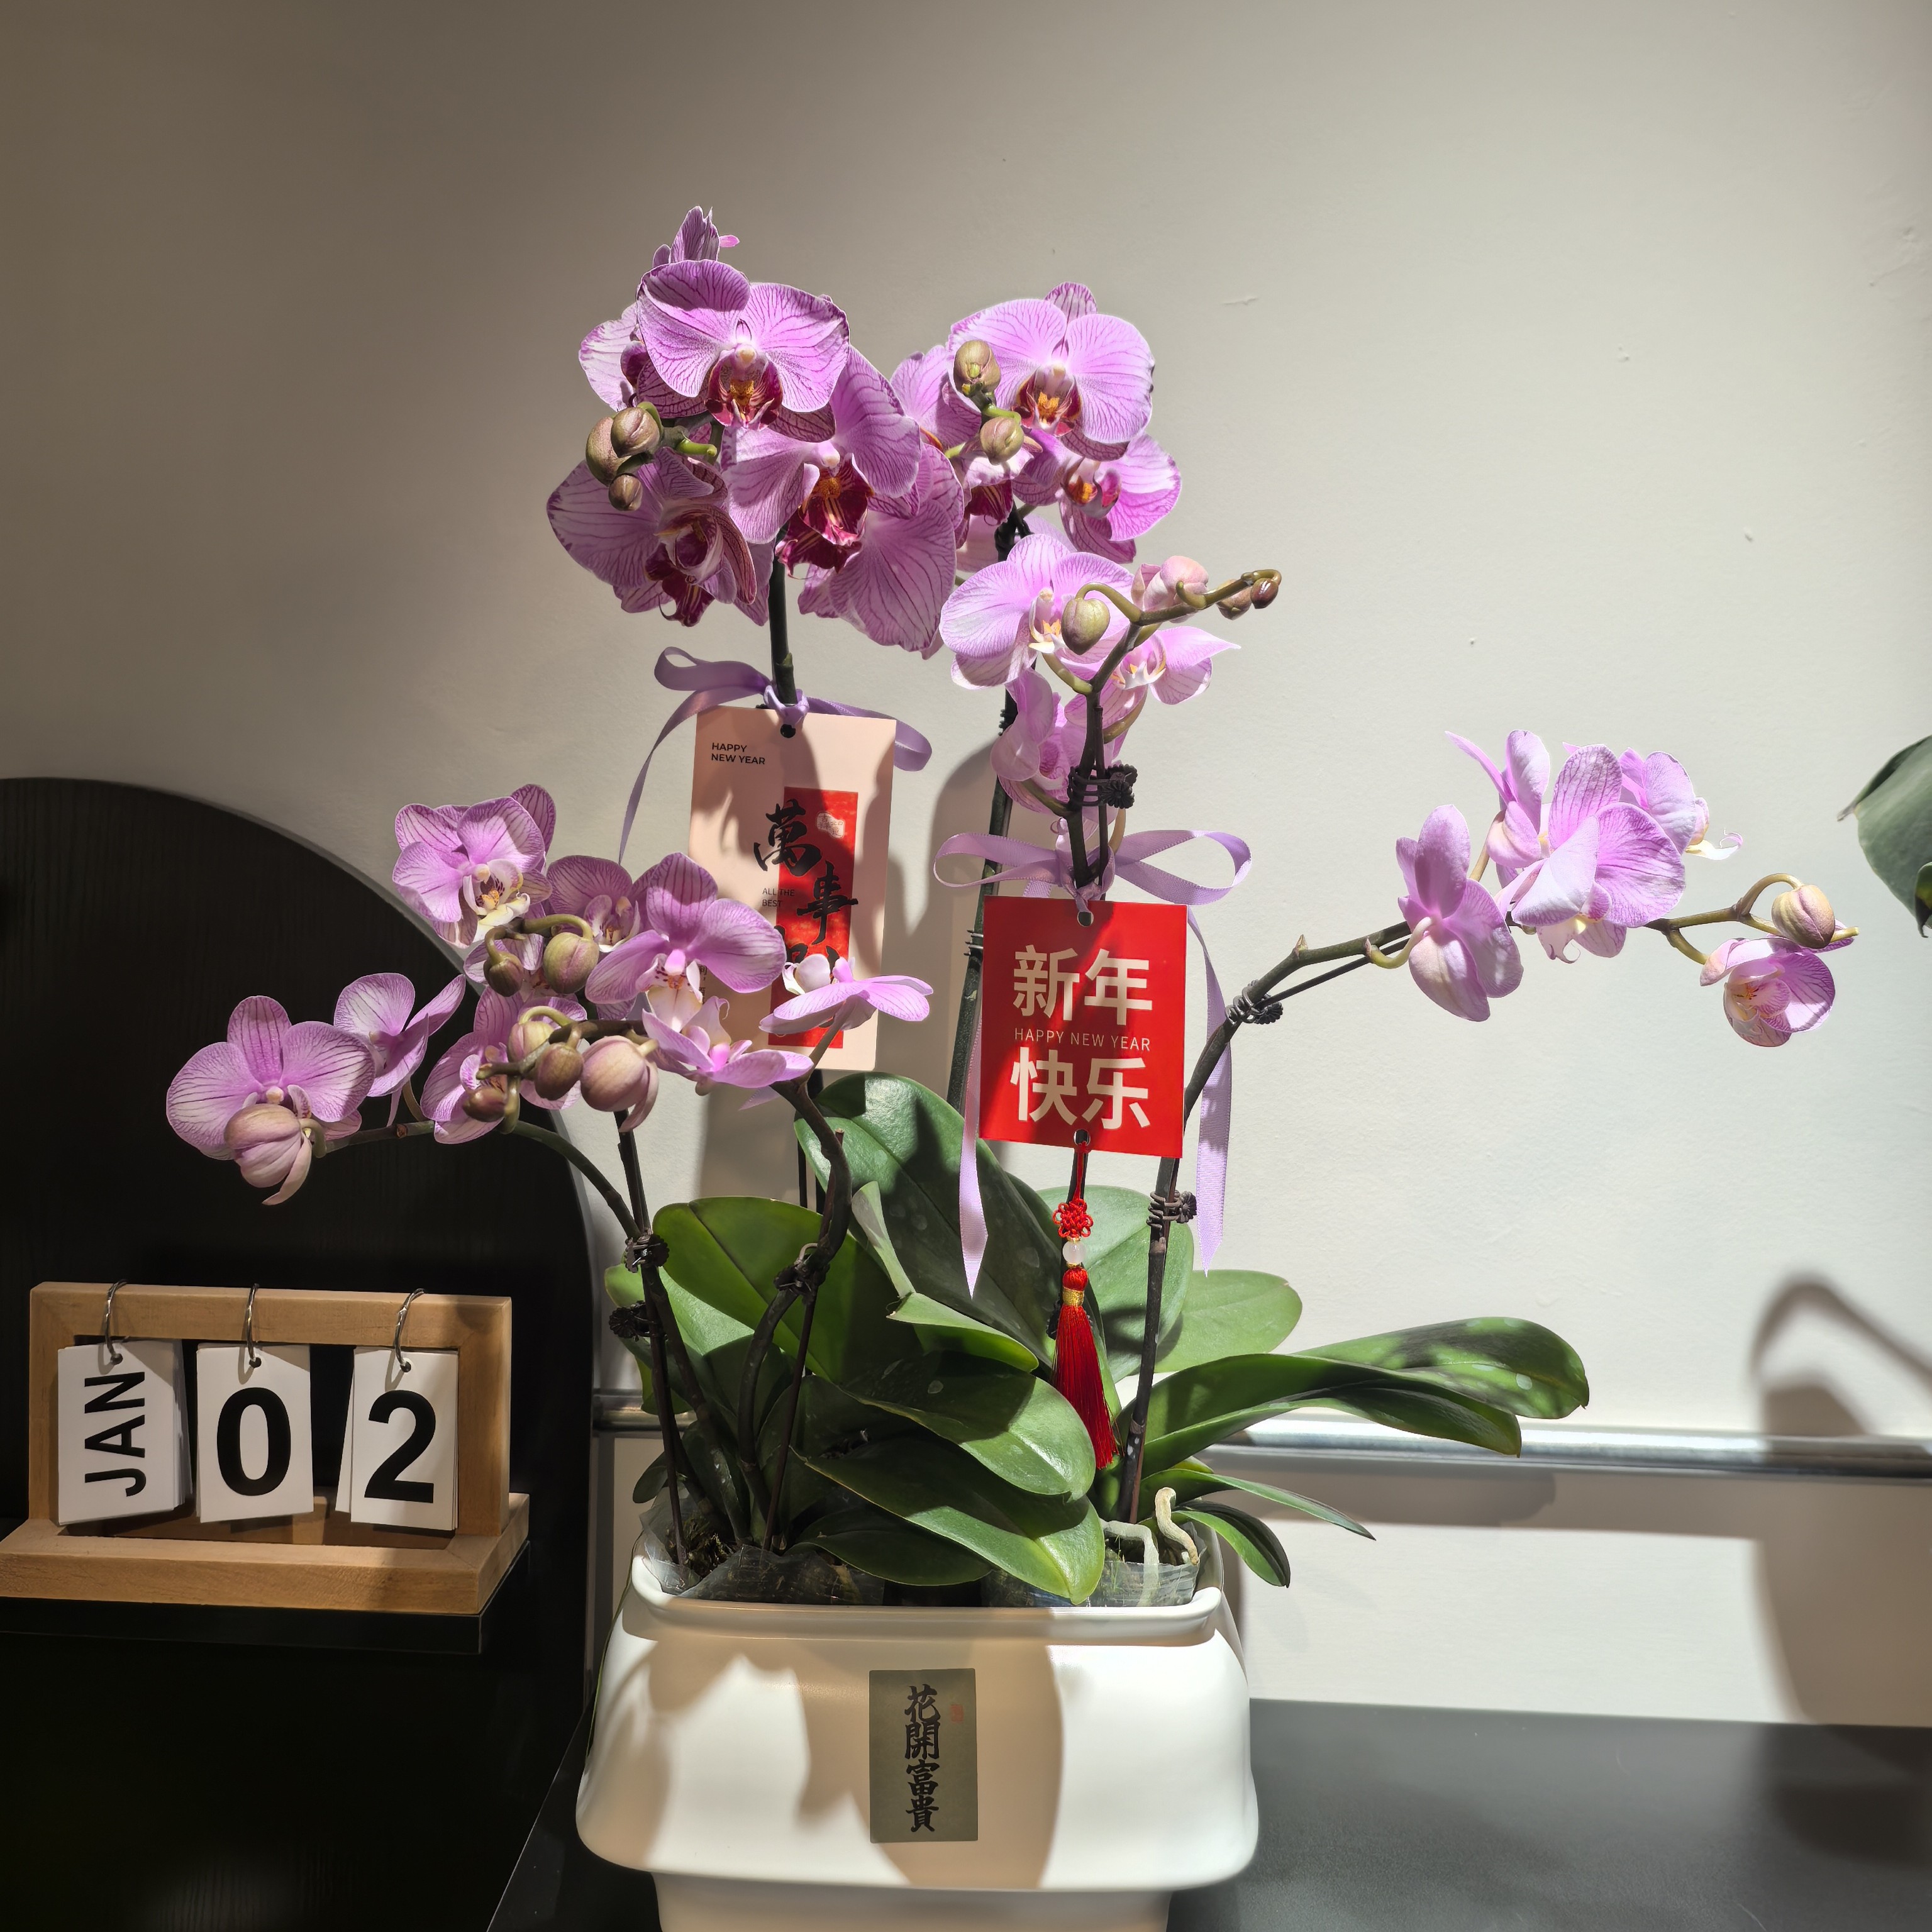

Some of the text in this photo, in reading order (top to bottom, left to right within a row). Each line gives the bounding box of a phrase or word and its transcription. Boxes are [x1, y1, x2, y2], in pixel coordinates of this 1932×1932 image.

[711, 742, 747, 752] HAPPY
[711, 753, 765, 765] NEW YEAR
[762, 887, 795, 897] ALL THE
[762, 899, 782, 907] BEST
[1013, 944, 1153, 1026] 新年
[1014, 1028, 1150, 1052] HAPPY NEW YEAR
[1010, 1046, 1151, 1130] 快乐
[84, 1371, 146, 1497] JAN
[364, 1390, 436, 1504] 2
[904, 1684, 941, 1833] 花開富貴
